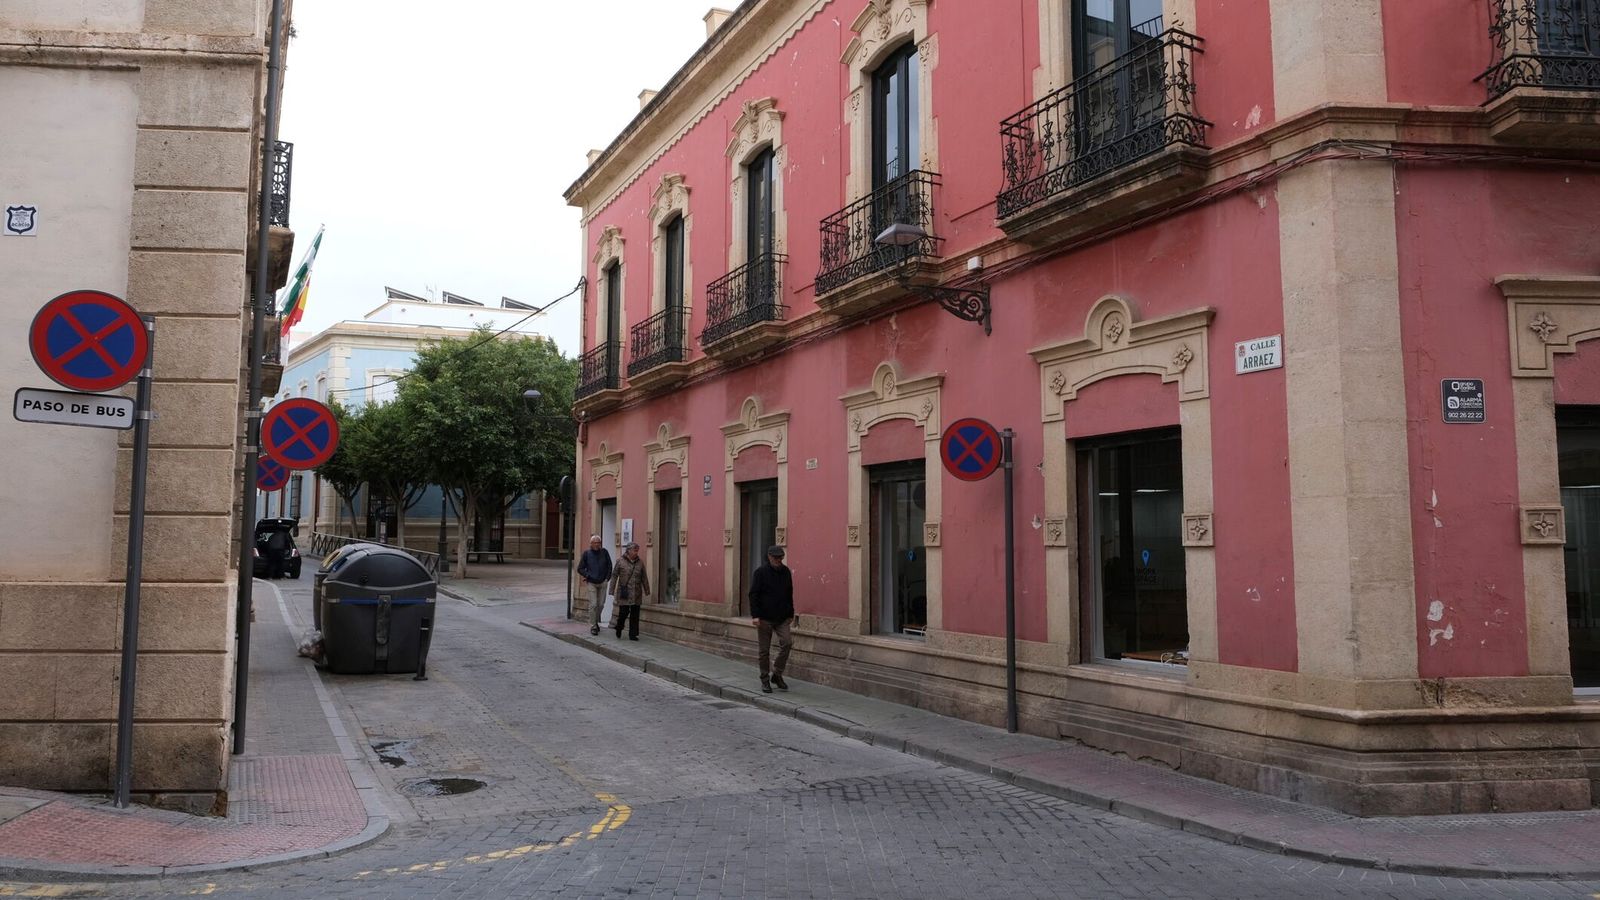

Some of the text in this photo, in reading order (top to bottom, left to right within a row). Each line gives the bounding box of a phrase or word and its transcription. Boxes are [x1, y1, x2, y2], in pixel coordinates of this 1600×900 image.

[1250, 340, 1276, 351] CALLE
[1243, 353, 1274, 369] ARRAEZ
[23, 399, 125, 417] PASO DE BUS
